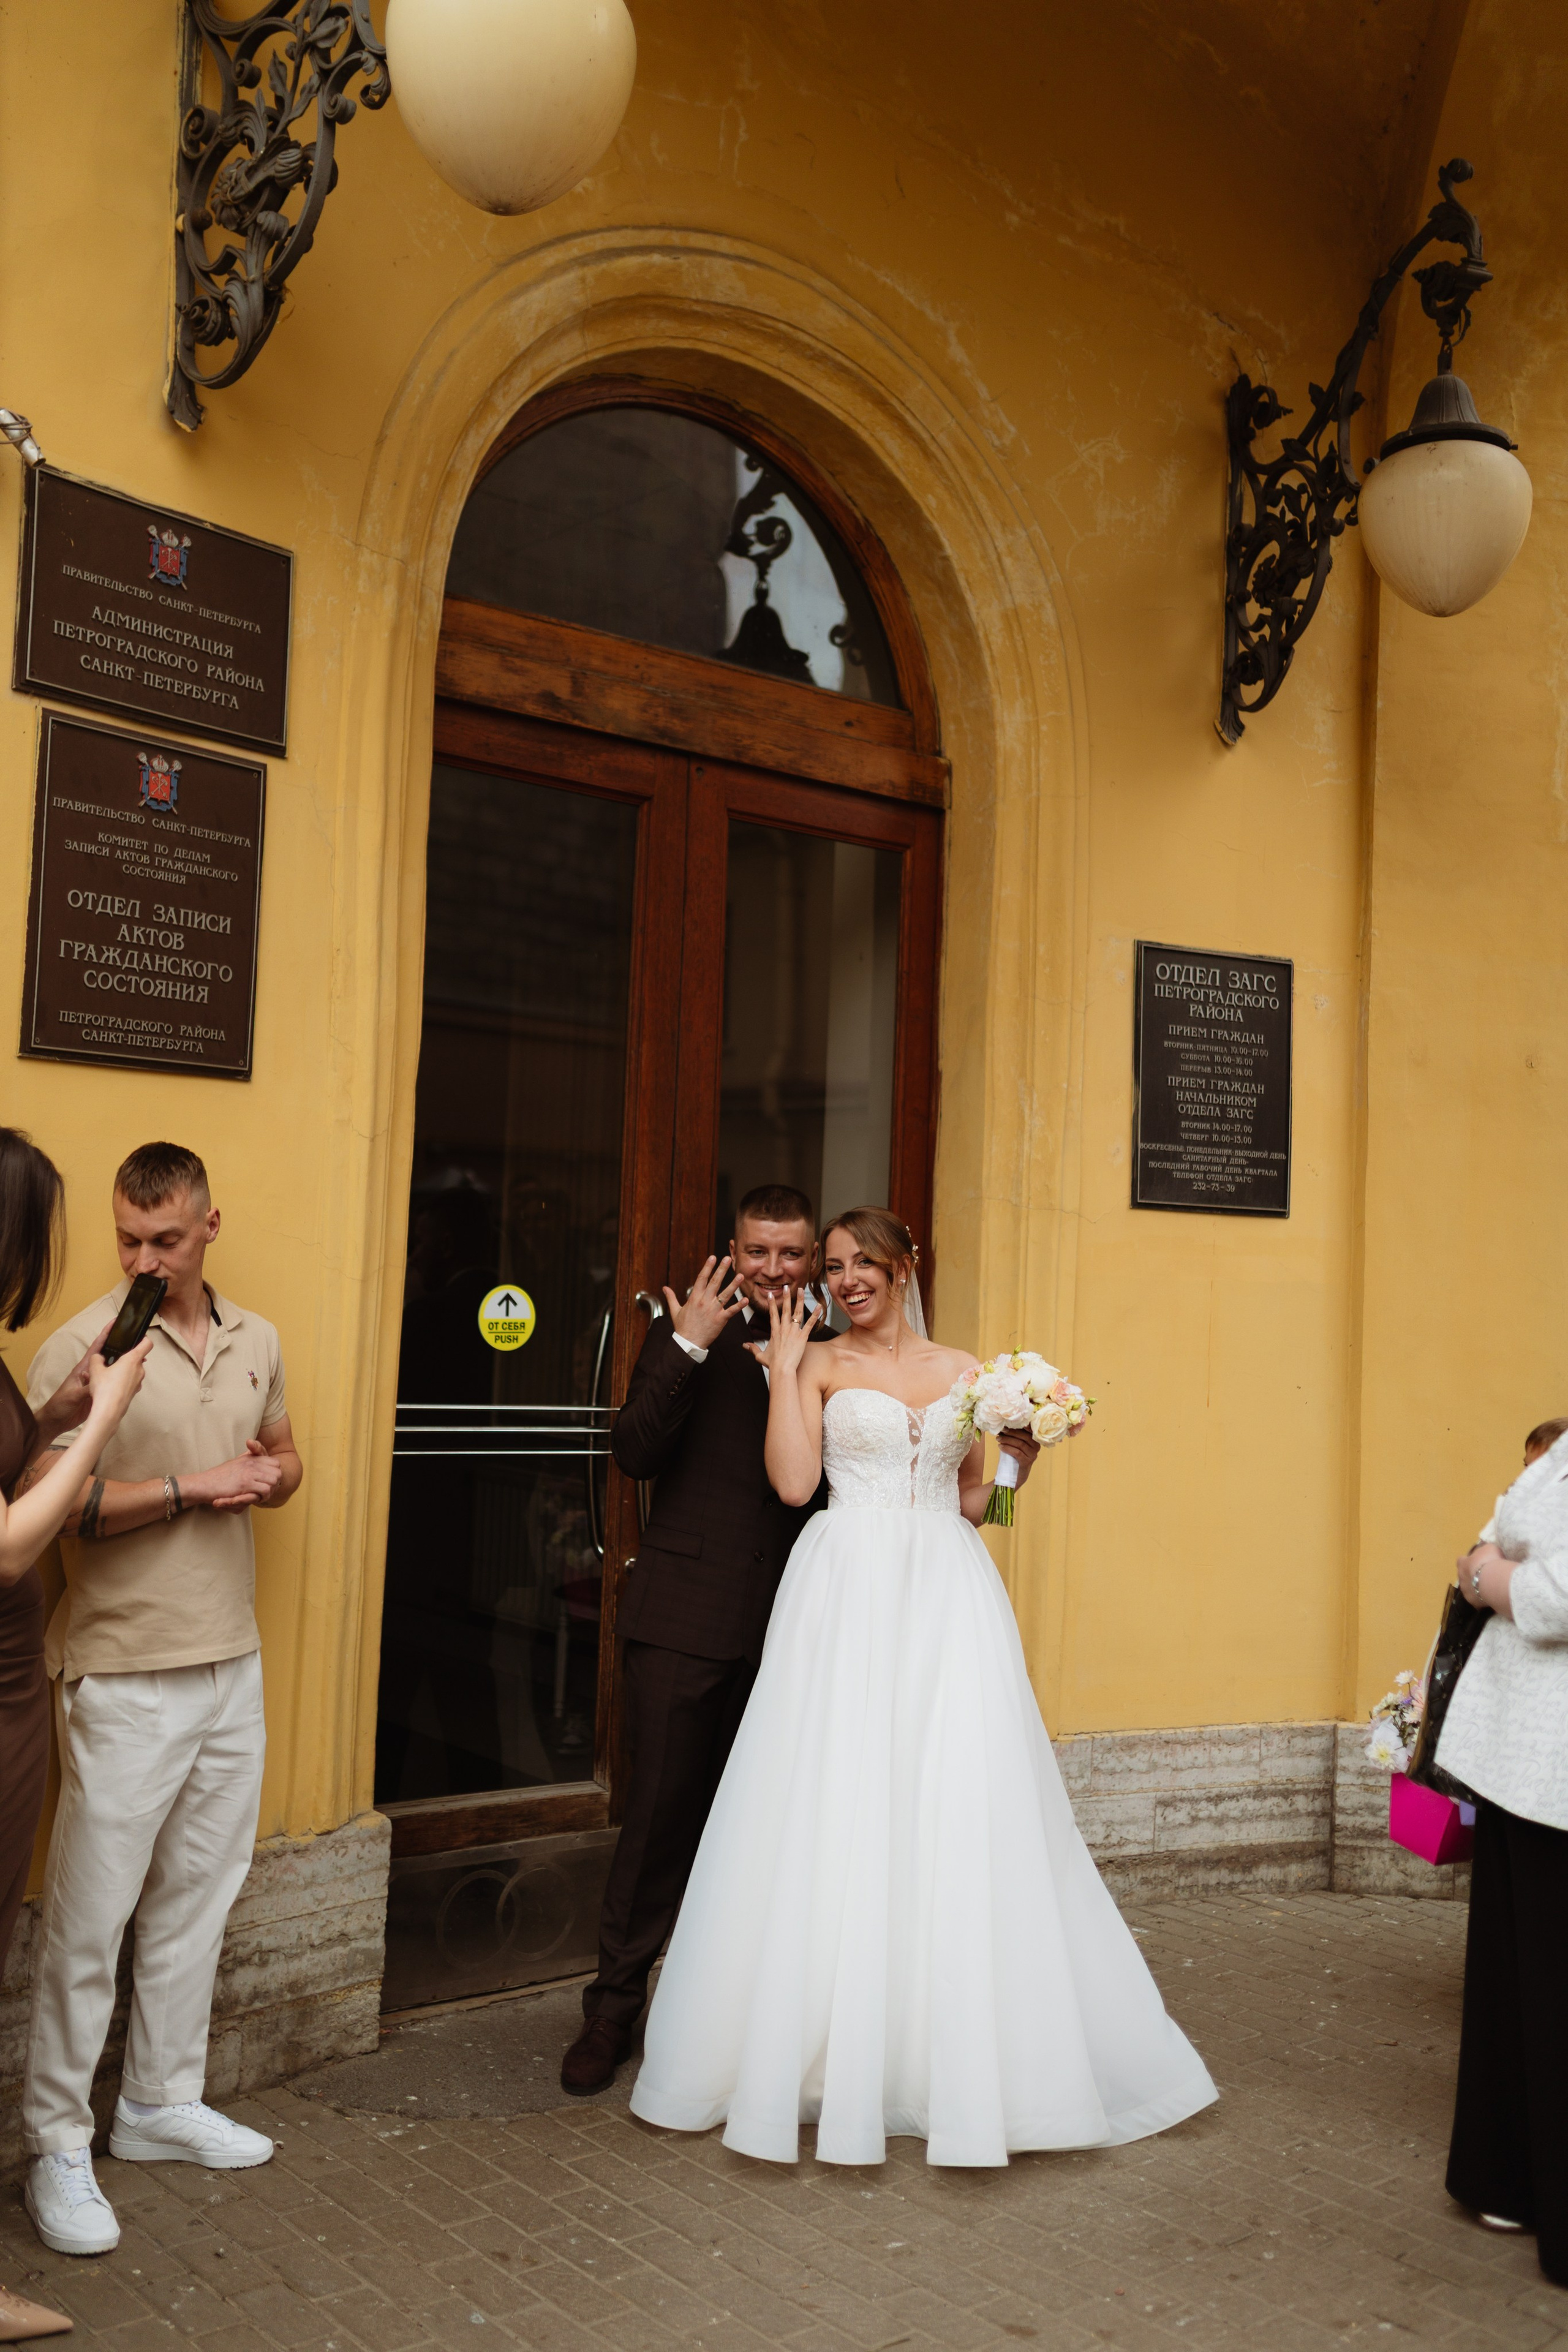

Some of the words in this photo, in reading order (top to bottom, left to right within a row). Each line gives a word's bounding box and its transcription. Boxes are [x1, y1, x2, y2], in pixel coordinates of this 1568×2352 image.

[62, 564, 153, 600] ПРАВИТЕЛЬСТВО
[159, 595, 262, 634] САНКТ-ПЕТЕРБУРГА
[92, 606, 233, 659] АДМИНИСТРАЦИЯ
[53, 620, 198, 673] ПЕТРОГРАДСКОГО
[207, 663, 265, 692] РАЙОНА
[80, 655, 239, 709] САНКТ-ПЕТЕРБУРГА
[53, 797, 145, 825] ПРАВИТЕЛЬСТВО
[152, 818, 251, 848] САНКТ-ПЕТЕРБУРГА
[98, 832, 148, 850] КОМИТЕТ
[154, 843, 168, 854] ПО
[175, 847, 211, 864] ДЕЛАМ
[64, 840, 109, 857] ЗАПИСИ
[115, 850, 149, 864] АКТОВ
[155, 858, 238, 882] ГРАЖДАНСКОГО
[123, 865, 186, 884] СОСТОЯНИЯ
[67, 889, 140, 918] ОТДЕЛ
[153, 905, 231, 935] ЗАПИСИ
[117, 924, 184, 950] АКТОВ
[59, 940, 232, 983] ГРАЖДАНСКОГО
[83, 970, 209, 1003] СОСТОЯНИЯ
[1156, 963, 1220, 986] ОТДЕЛ
[1228, 971, 1276, 993] ЗАГС
[1155, 984, 1280, 1009] ПЕТРОГРАДСКОГО
[1189, 1003, 1243, 1022] РАЙОНА
[59, 1011, 172, 1035] ПЕТРОГРАДСКОГО
[179, 1023, 226, 1041] РАЙОНА
[1169, 1025, 1207, 1038] ПРИЕМ
[1211, 1029, 1264, 1044] ГРАЖДАН
[82, 1029, 203, 1053] САНКТ-ПЕТЕРБУРГА
[1180, 1065, 1211, 1073] ПЕРЕРЫВ
[1167, 1076, 1205, 1089] ПРИЕМ
[1210, 1080, 1264, 1095] ГРАЖДАН
[1176, 1091, 1256, 1107] НАЧАЛЬНИКОМ
[1178, 1105, 1221, 1117] ОТДЕЛА
[1227, 1109, 1253, 1120] ЗАГС
[1182, 1121, 1210, 1129] ВТОРНИК
[1180, 1133, 1208, 1141] ЧЕТВЕРГ
[1149, 1161, 1189, 1170] ПОСЛЕДНИЙ
[1183, 1155, 1226, 1163] САНИТАРНЫЙ
